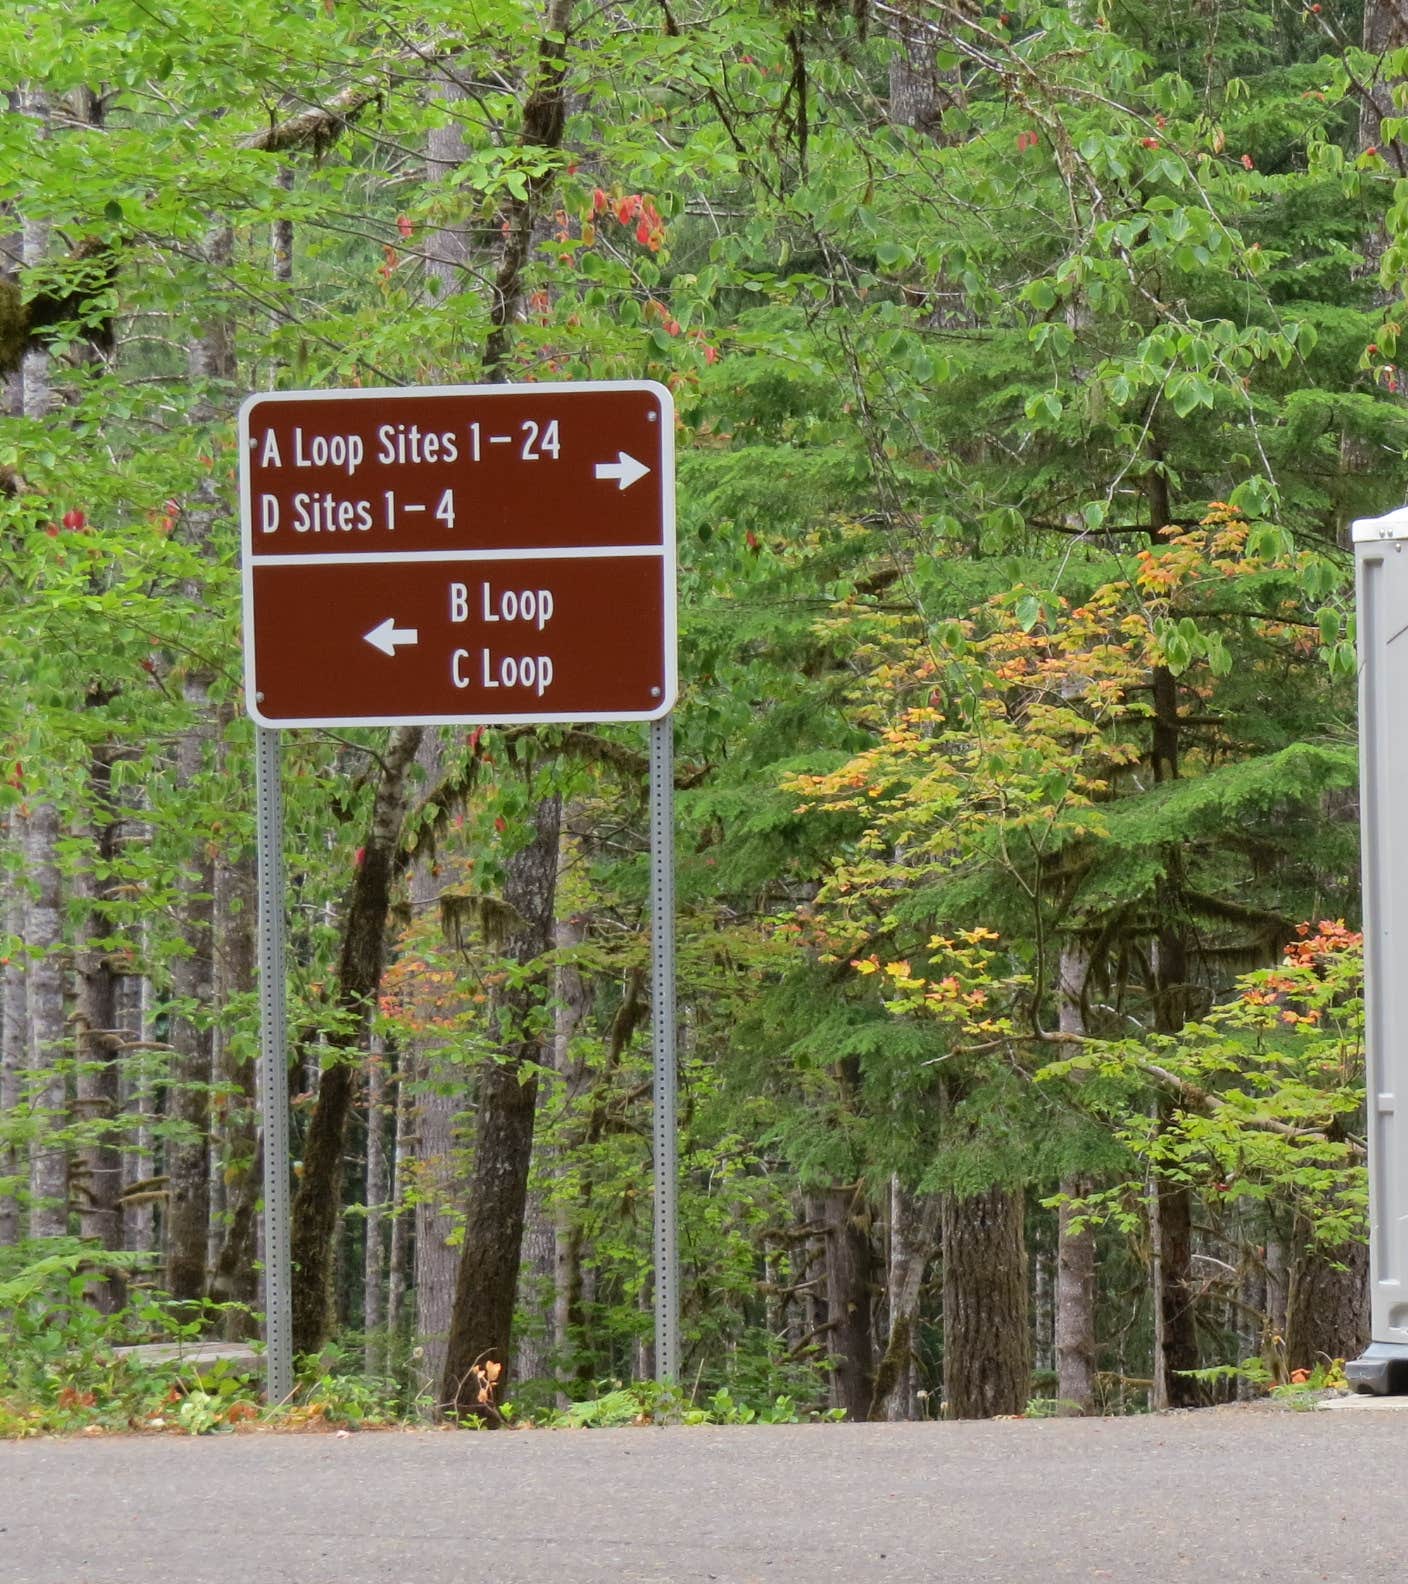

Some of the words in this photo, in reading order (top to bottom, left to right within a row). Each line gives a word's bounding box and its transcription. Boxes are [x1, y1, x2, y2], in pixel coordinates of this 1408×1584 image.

[261, 428, 282, 468] A
[295, 427, 364, 476] Loop
[378, 424, 458, 465] Sites
[261, 494, 280, 534] D
[293, 492, 373, 533] Sites
[450, 582, 469, 623] B
[483, 581, 554, 631] Loop
[452, 648, 470, 689] C
[483, 648, 554, 697] Loop
